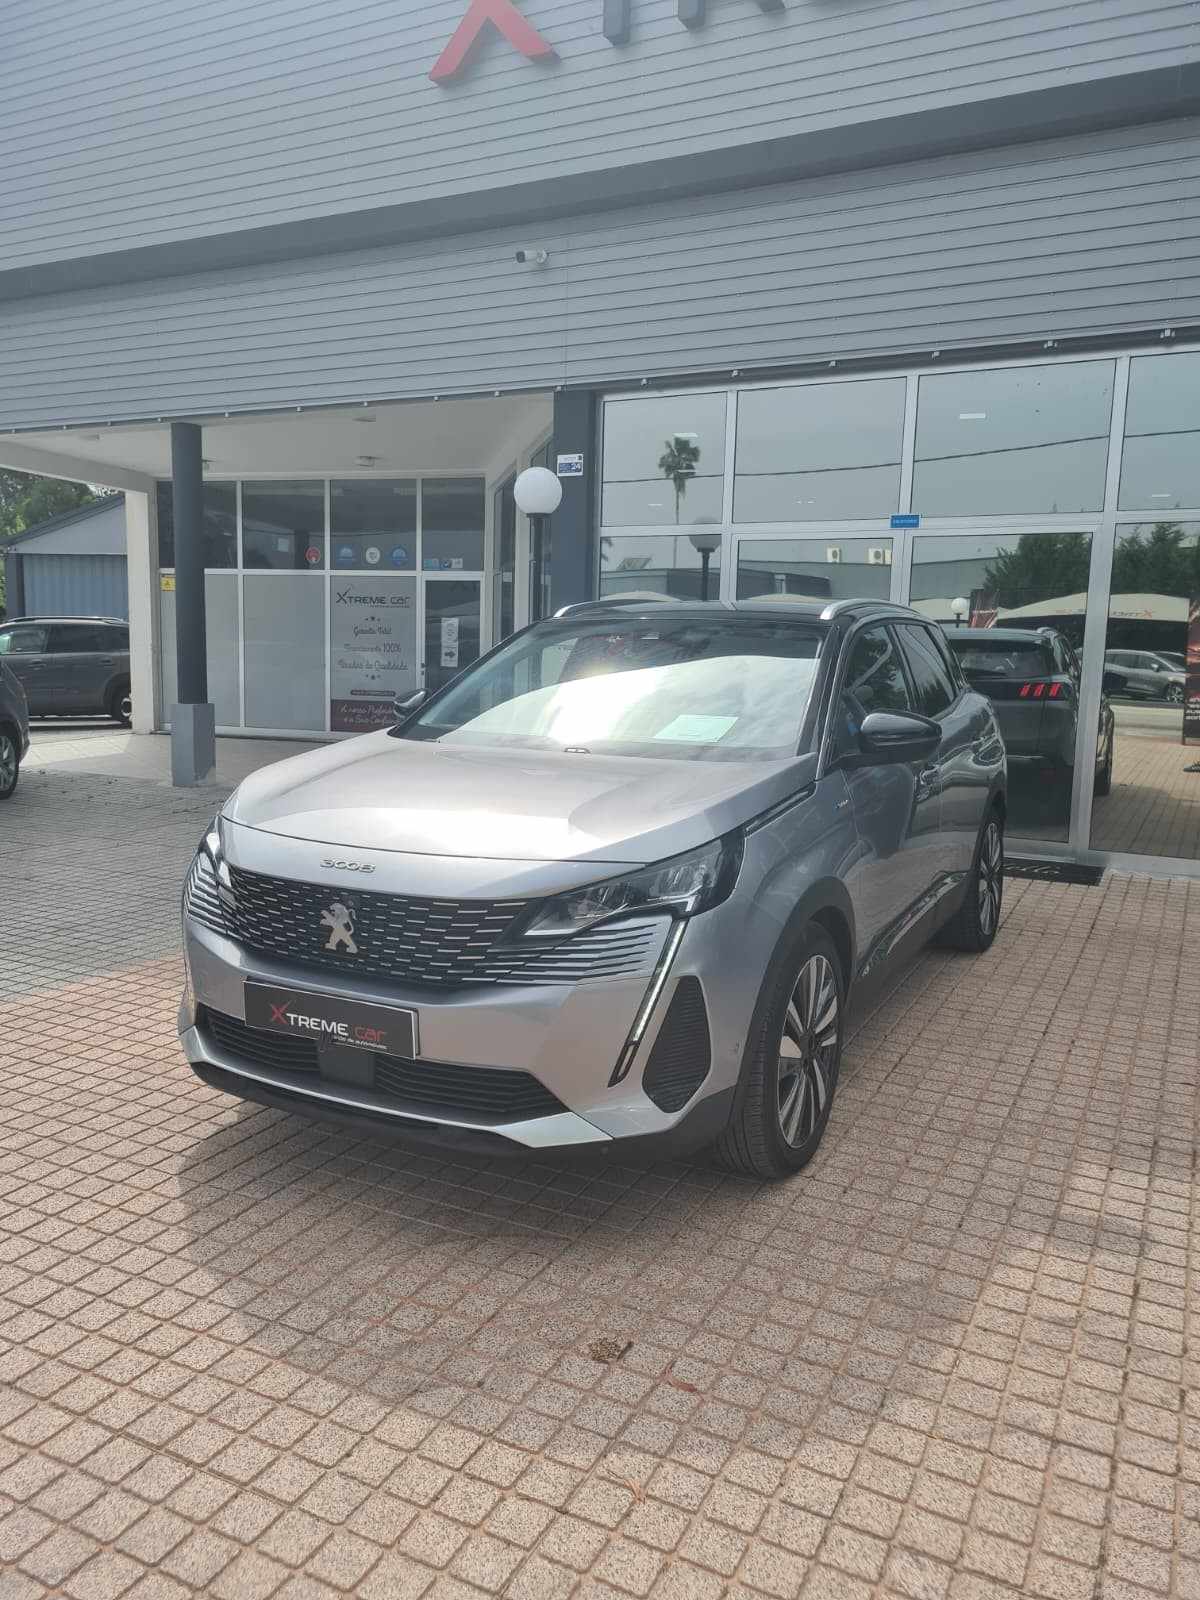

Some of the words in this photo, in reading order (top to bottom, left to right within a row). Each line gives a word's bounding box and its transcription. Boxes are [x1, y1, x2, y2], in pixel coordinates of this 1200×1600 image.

[320, 858, 376, 873] 3008
[270, 1001, 349, 1037] XTREME
[355, 1026, 387, 1041] car
